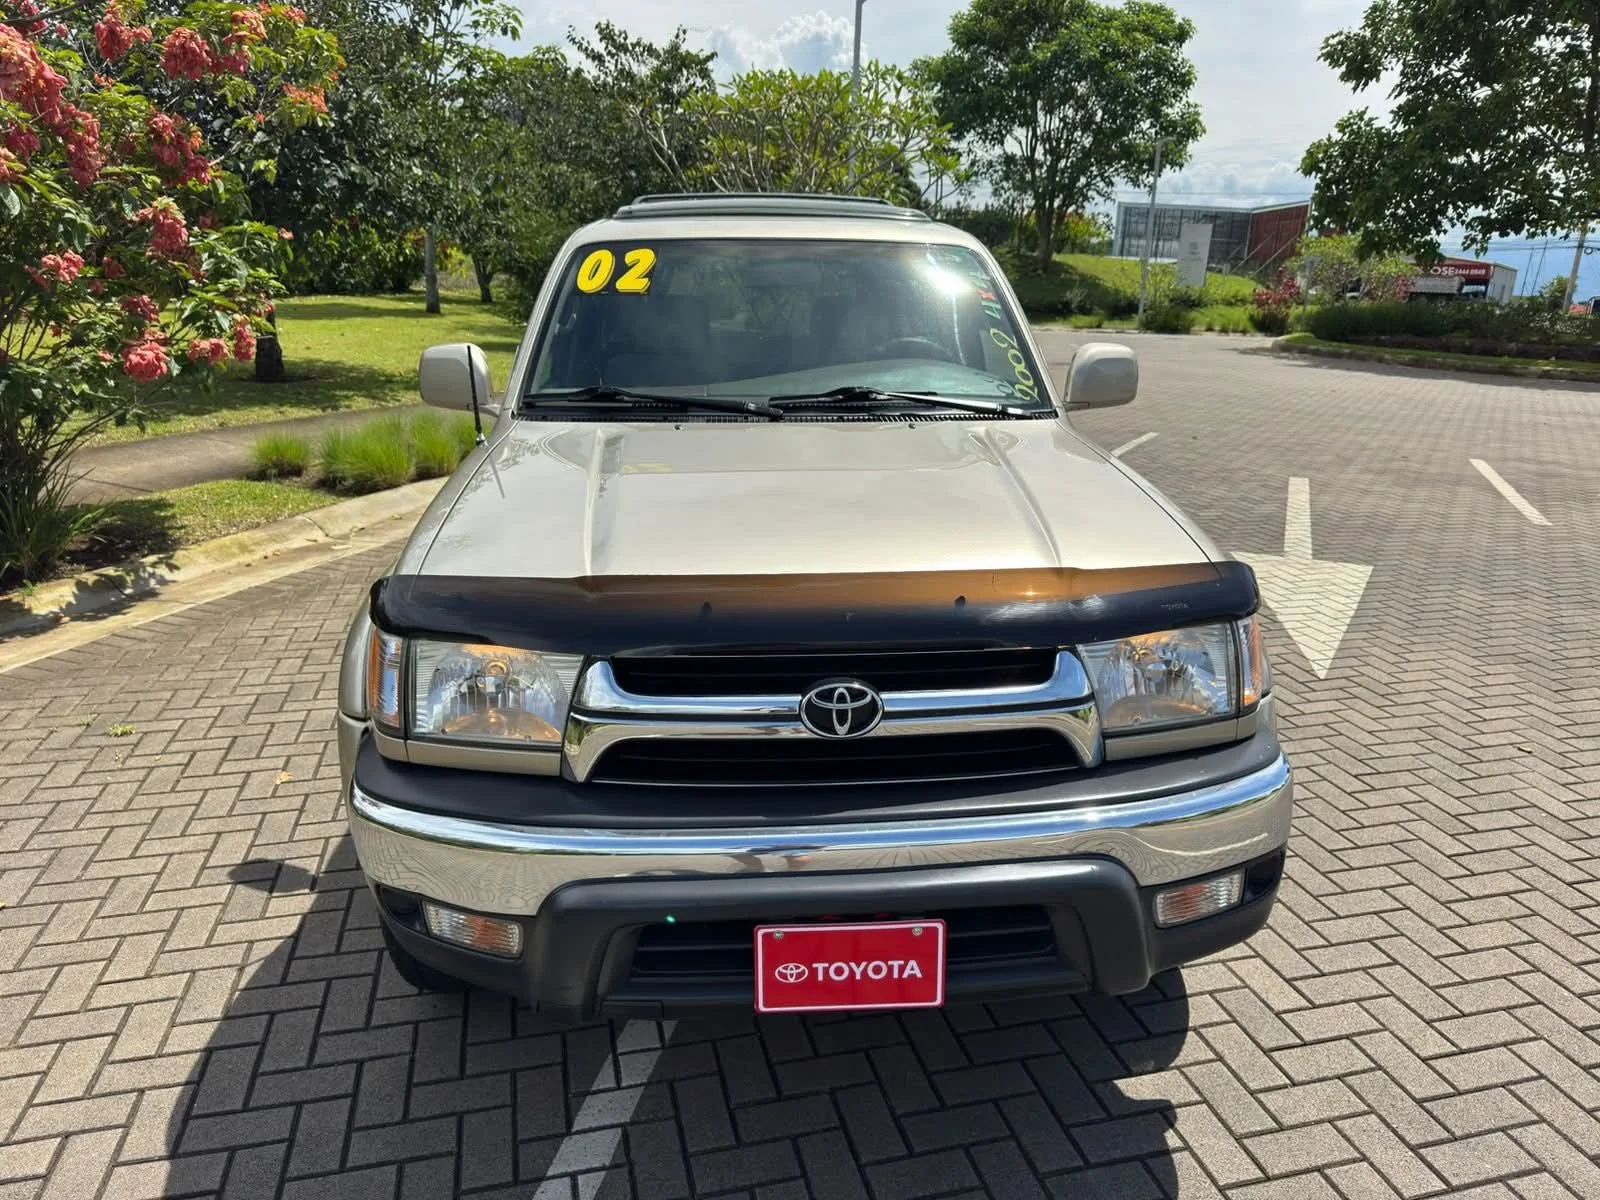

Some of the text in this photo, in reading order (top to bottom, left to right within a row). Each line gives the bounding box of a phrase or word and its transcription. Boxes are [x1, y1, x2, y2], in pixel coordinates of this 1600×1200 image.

[576, 248, 656, 294] 02
[990, 328, 1041, 402] 2002
[811, 959, 923, 981] TOYOTA
